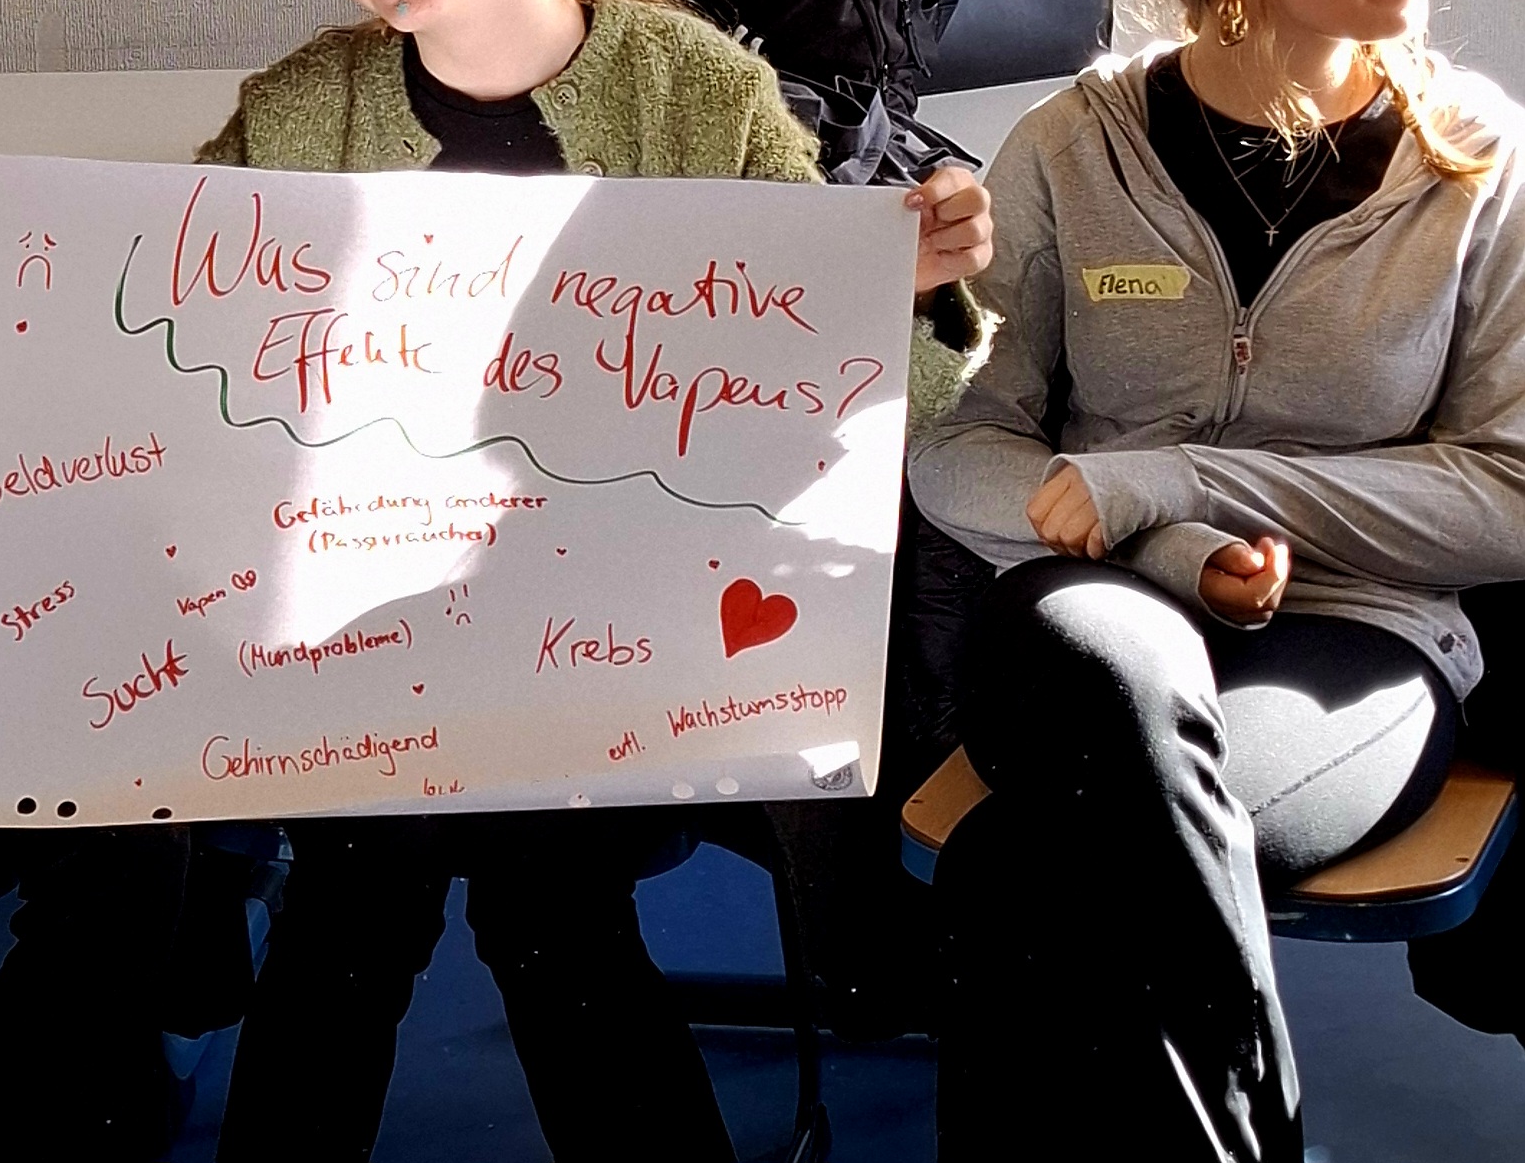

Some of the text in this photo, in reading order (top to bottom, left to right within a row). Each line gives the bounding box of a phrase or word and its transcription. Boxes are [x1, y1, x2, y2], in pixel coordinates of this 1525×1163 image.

[170, 175, 333, 306] Was
[550, 259, 820, 337] negative
[482, 332, 563, 399] des
[594, 333, 885, 457] Vapens?
[445, 492, 549, 510] anderer
[238, 618, 413, 678] (Mundprobleme)
[535, 617, 653, 674] Krebs
[82, 638, 190, 729] Sucht
[666, 684, 848, 738] Wachstumsstopp
[202, 725, 440, 781] Gehirnschädigend
